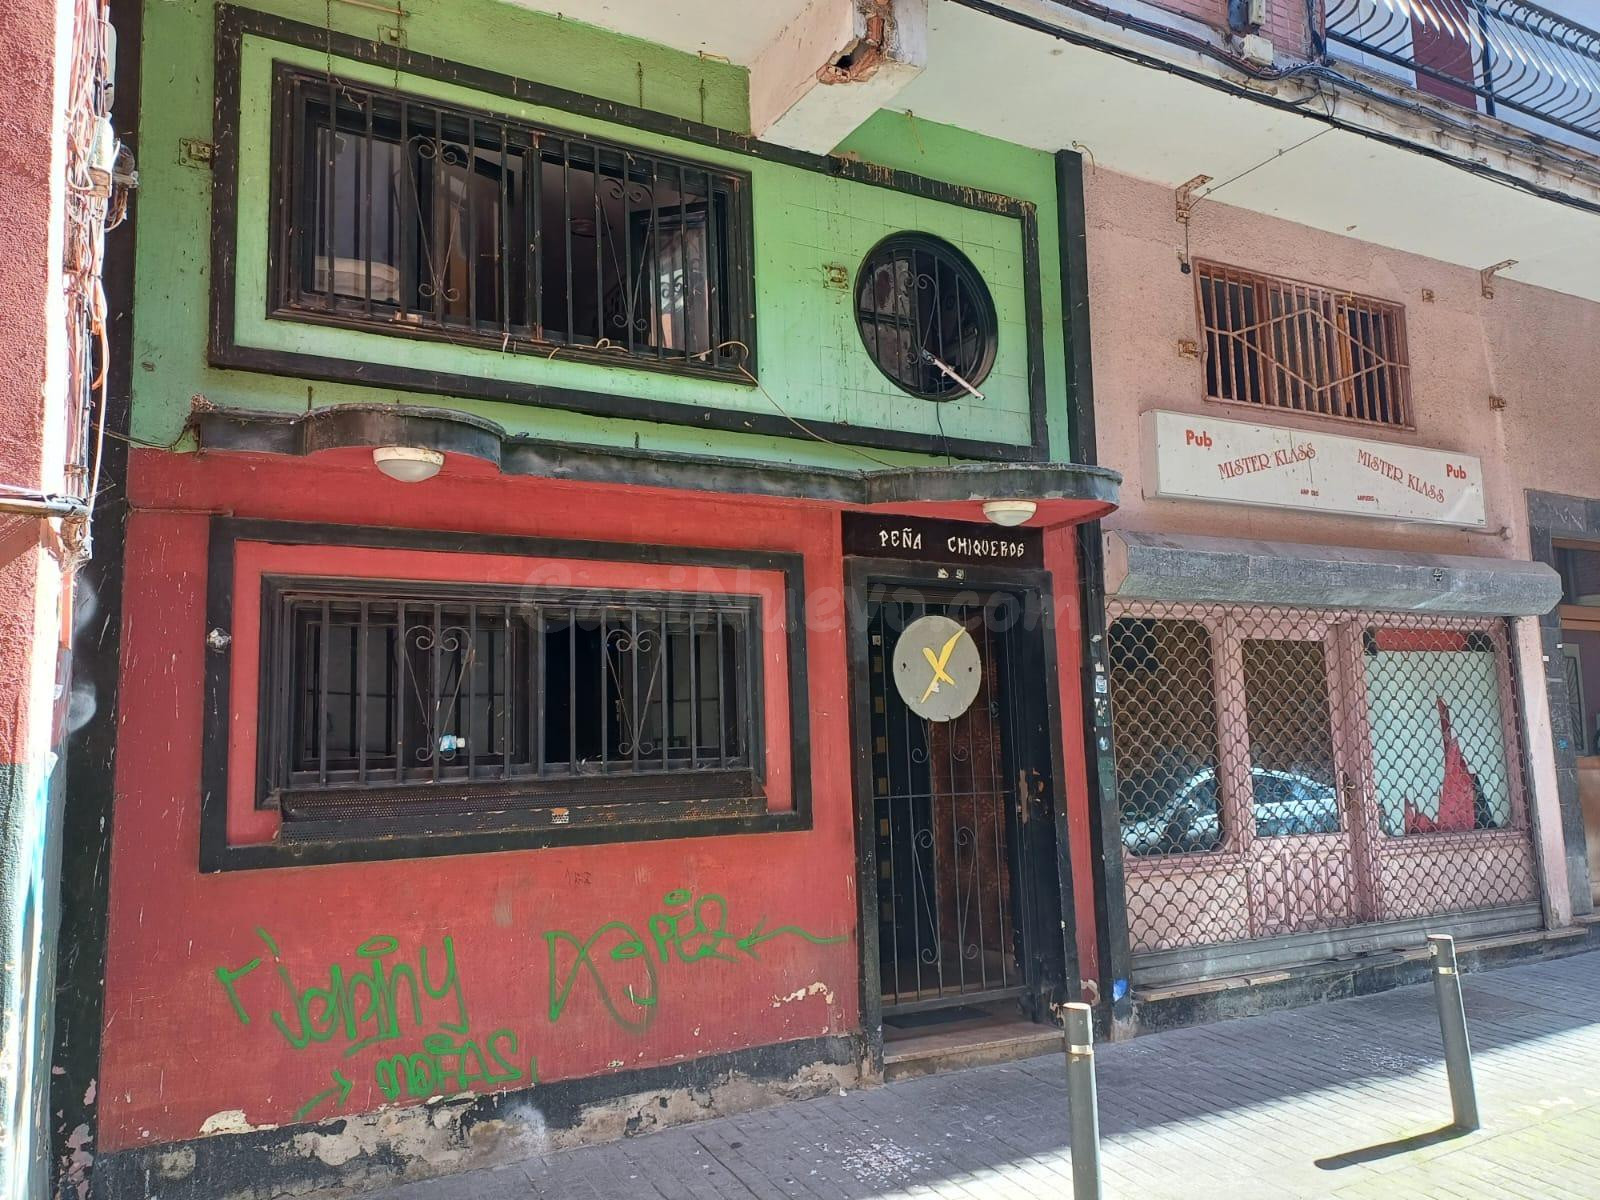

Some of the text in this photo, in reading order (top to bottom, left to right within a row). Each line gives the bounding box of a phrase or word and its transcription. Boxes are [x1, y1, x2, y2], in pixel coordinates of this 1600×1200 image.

[1185, 429, 1213, 448] Pub
[1217, 442, 1318, 481] MISTER KLASS
[1357, 449, 1446, 504] MISTER KLASS
[1445, 463, 1468, 480] Pub
[878, 527, 1026, 558] PEÑA CHIQUEROS
